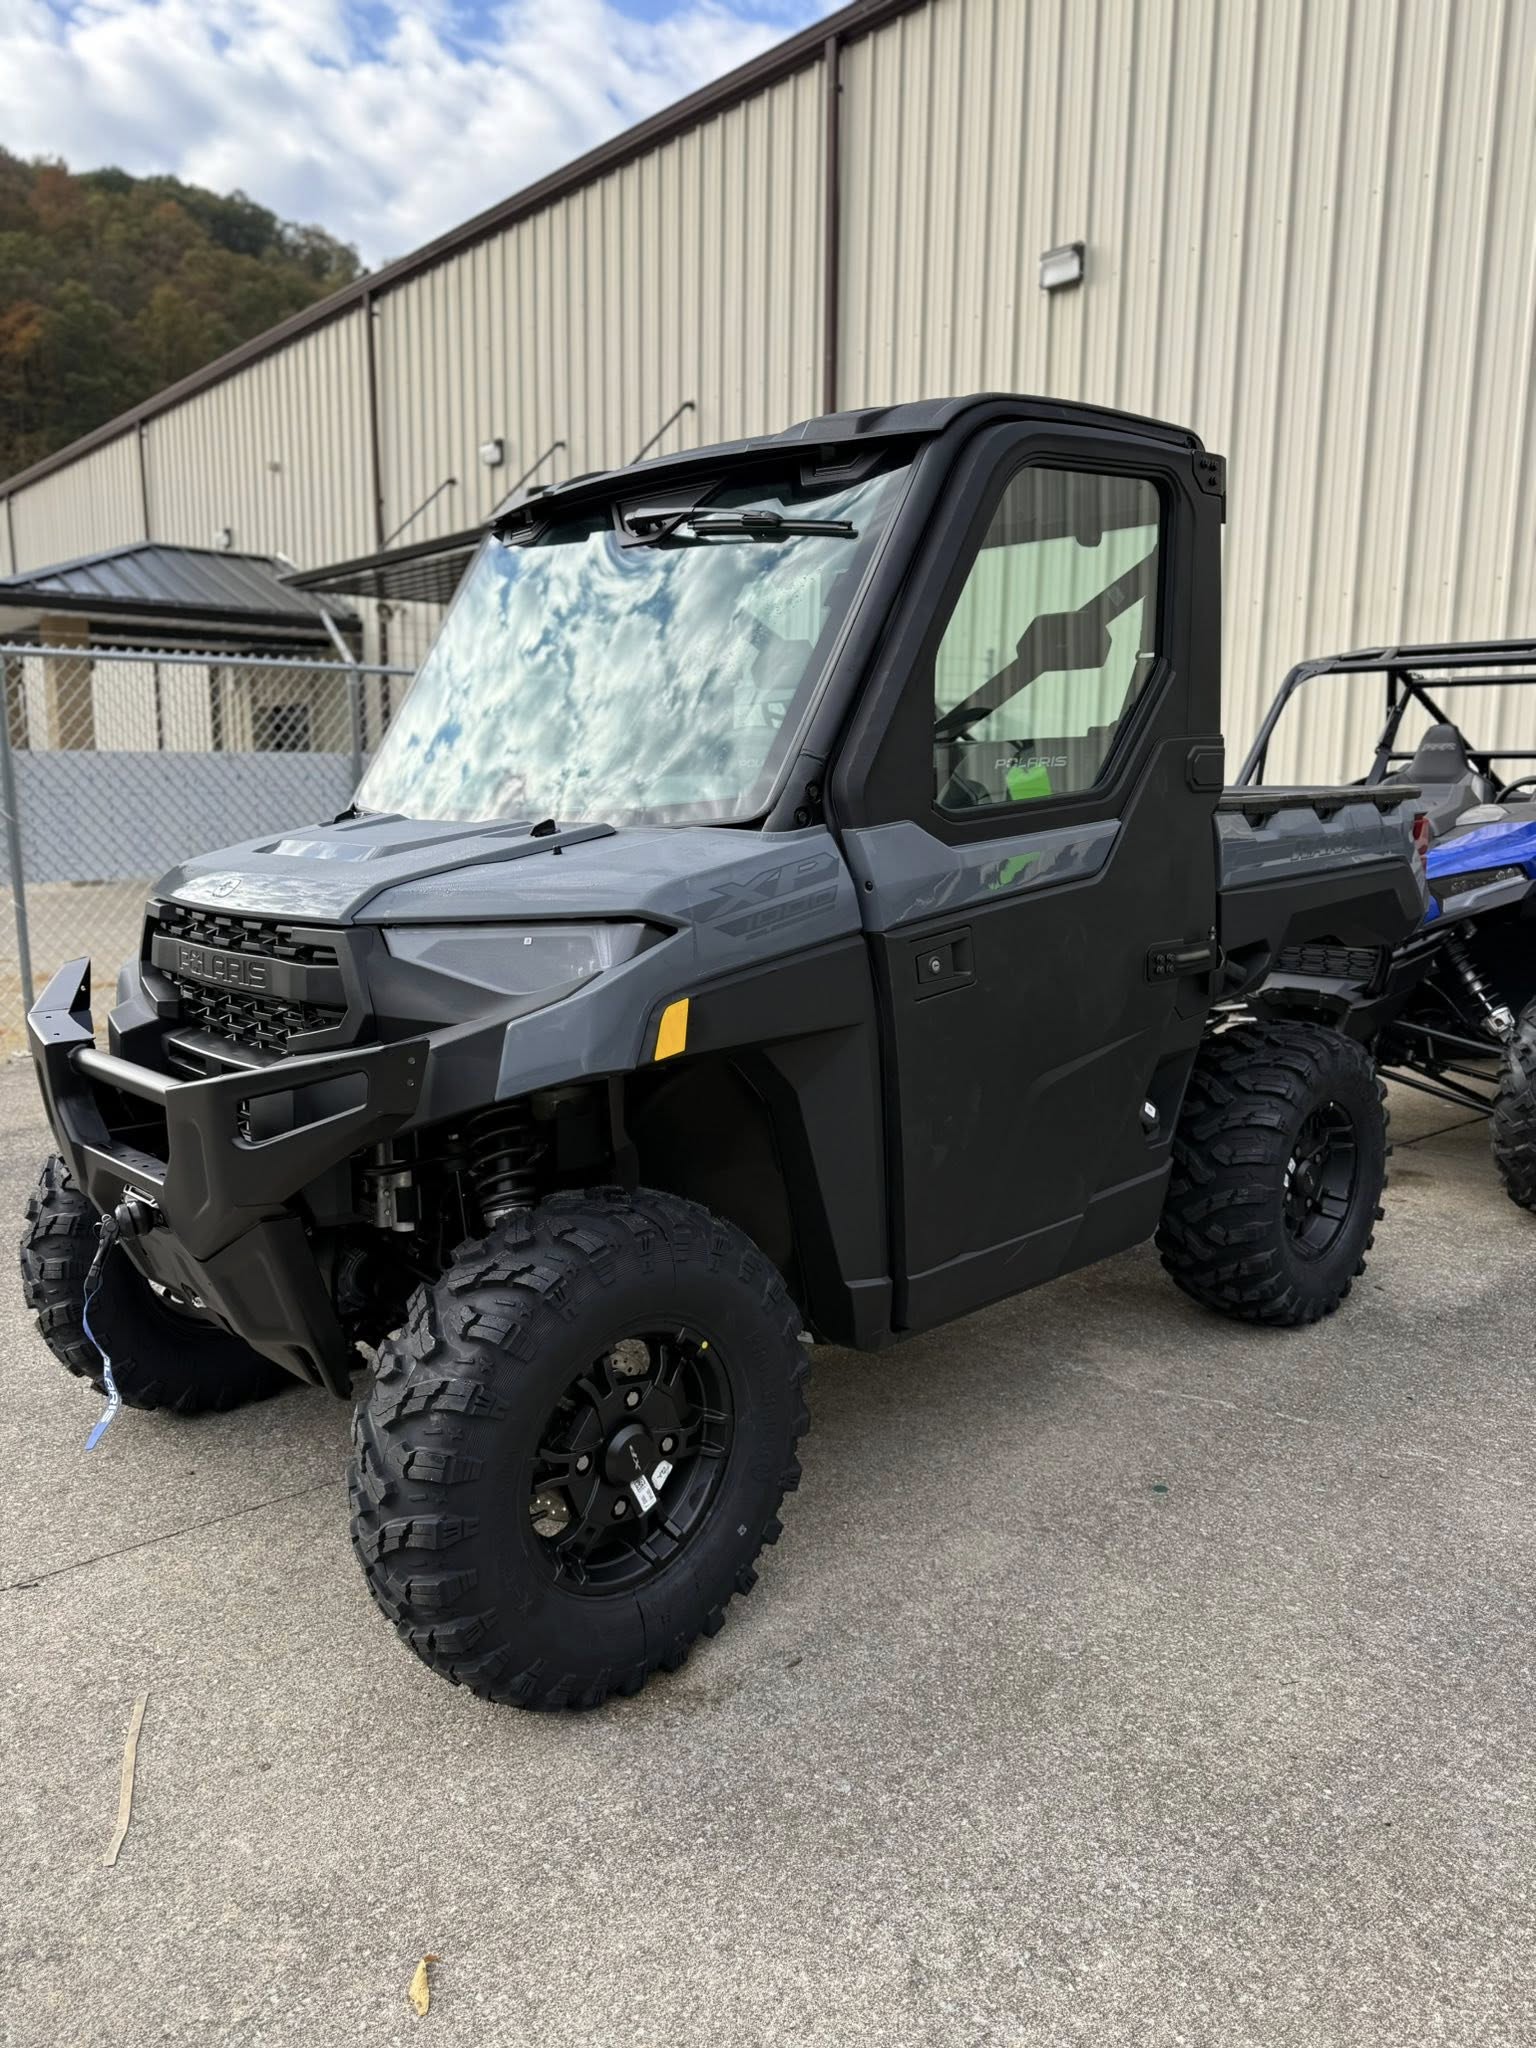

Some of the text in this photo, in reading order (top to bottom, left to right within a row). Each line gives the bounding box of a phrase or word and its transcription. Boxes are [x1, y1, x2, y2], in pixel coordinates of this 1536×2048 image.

[994, 755, 1069, 769] POLARIS
[704, 851, 839, 922] XP
[177, 944, 267, 989] POLARIS
